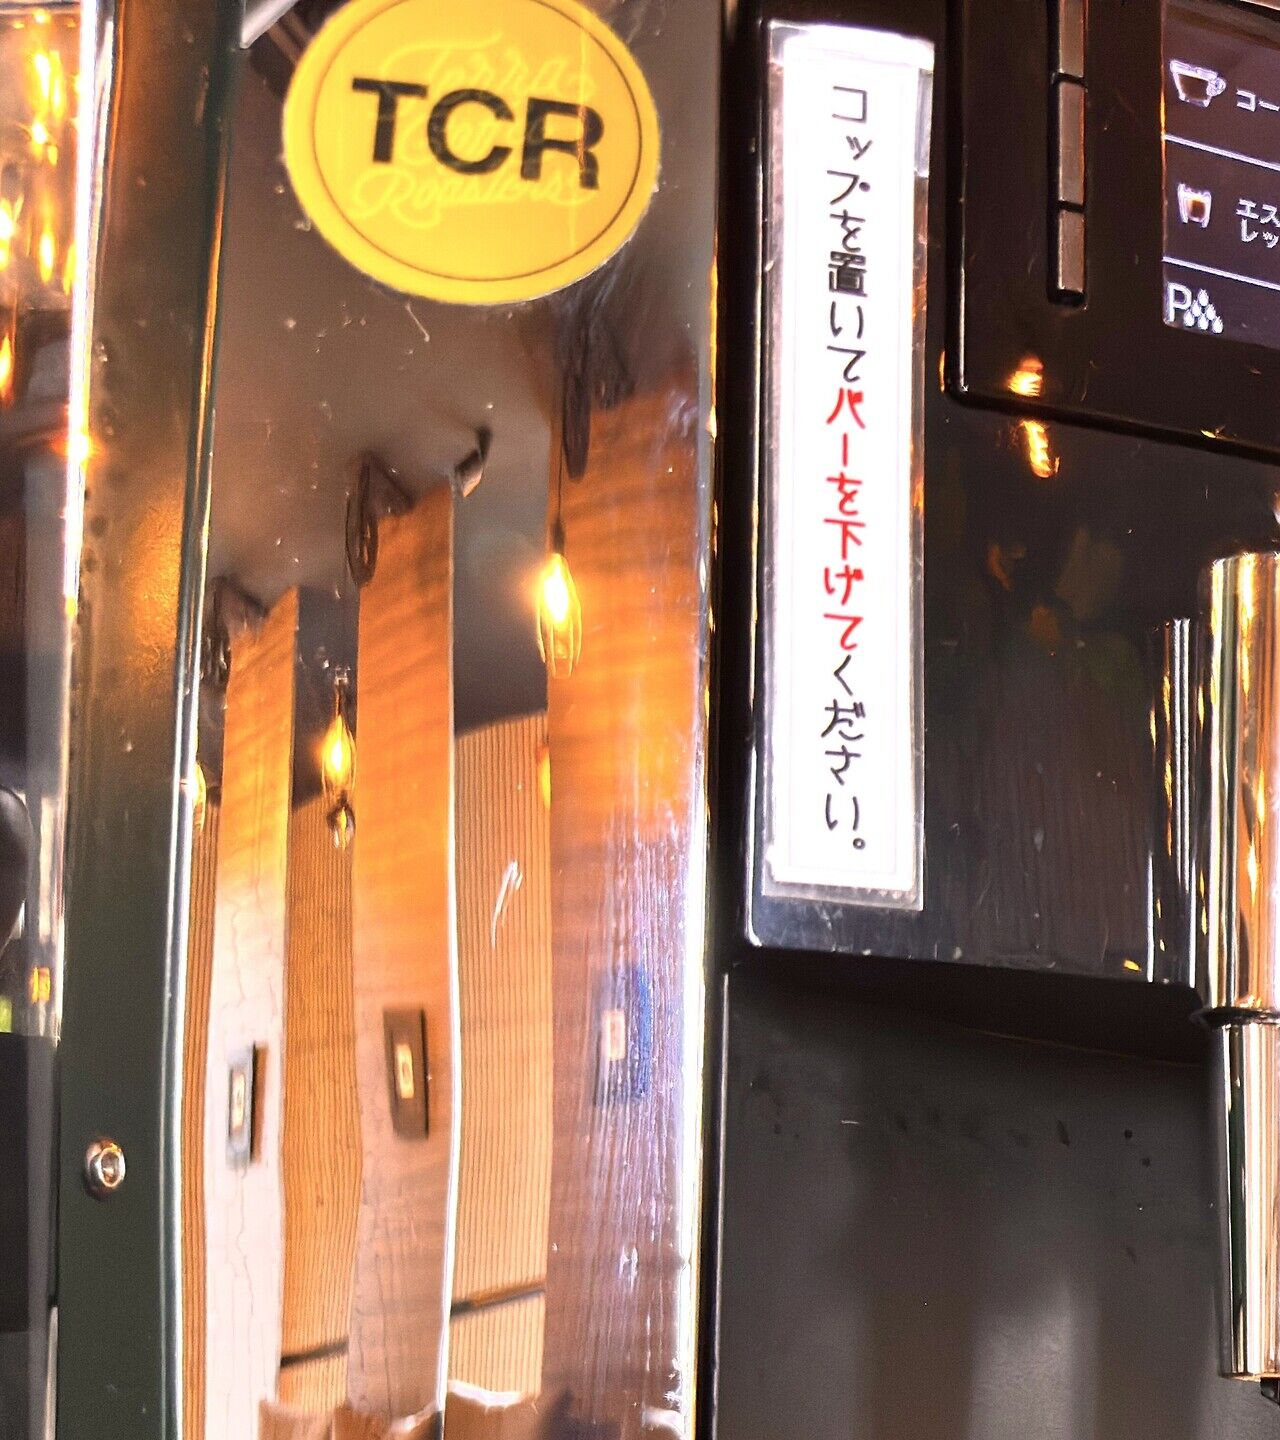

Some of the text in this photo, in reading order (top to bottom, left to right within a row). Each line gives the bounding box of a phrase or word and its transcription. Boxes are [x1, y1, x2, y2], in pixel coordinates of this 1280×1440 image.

[351, 77, 605, 191] TCR
[821, 85, 873, 851] コップを置いてバーを下げてください。
